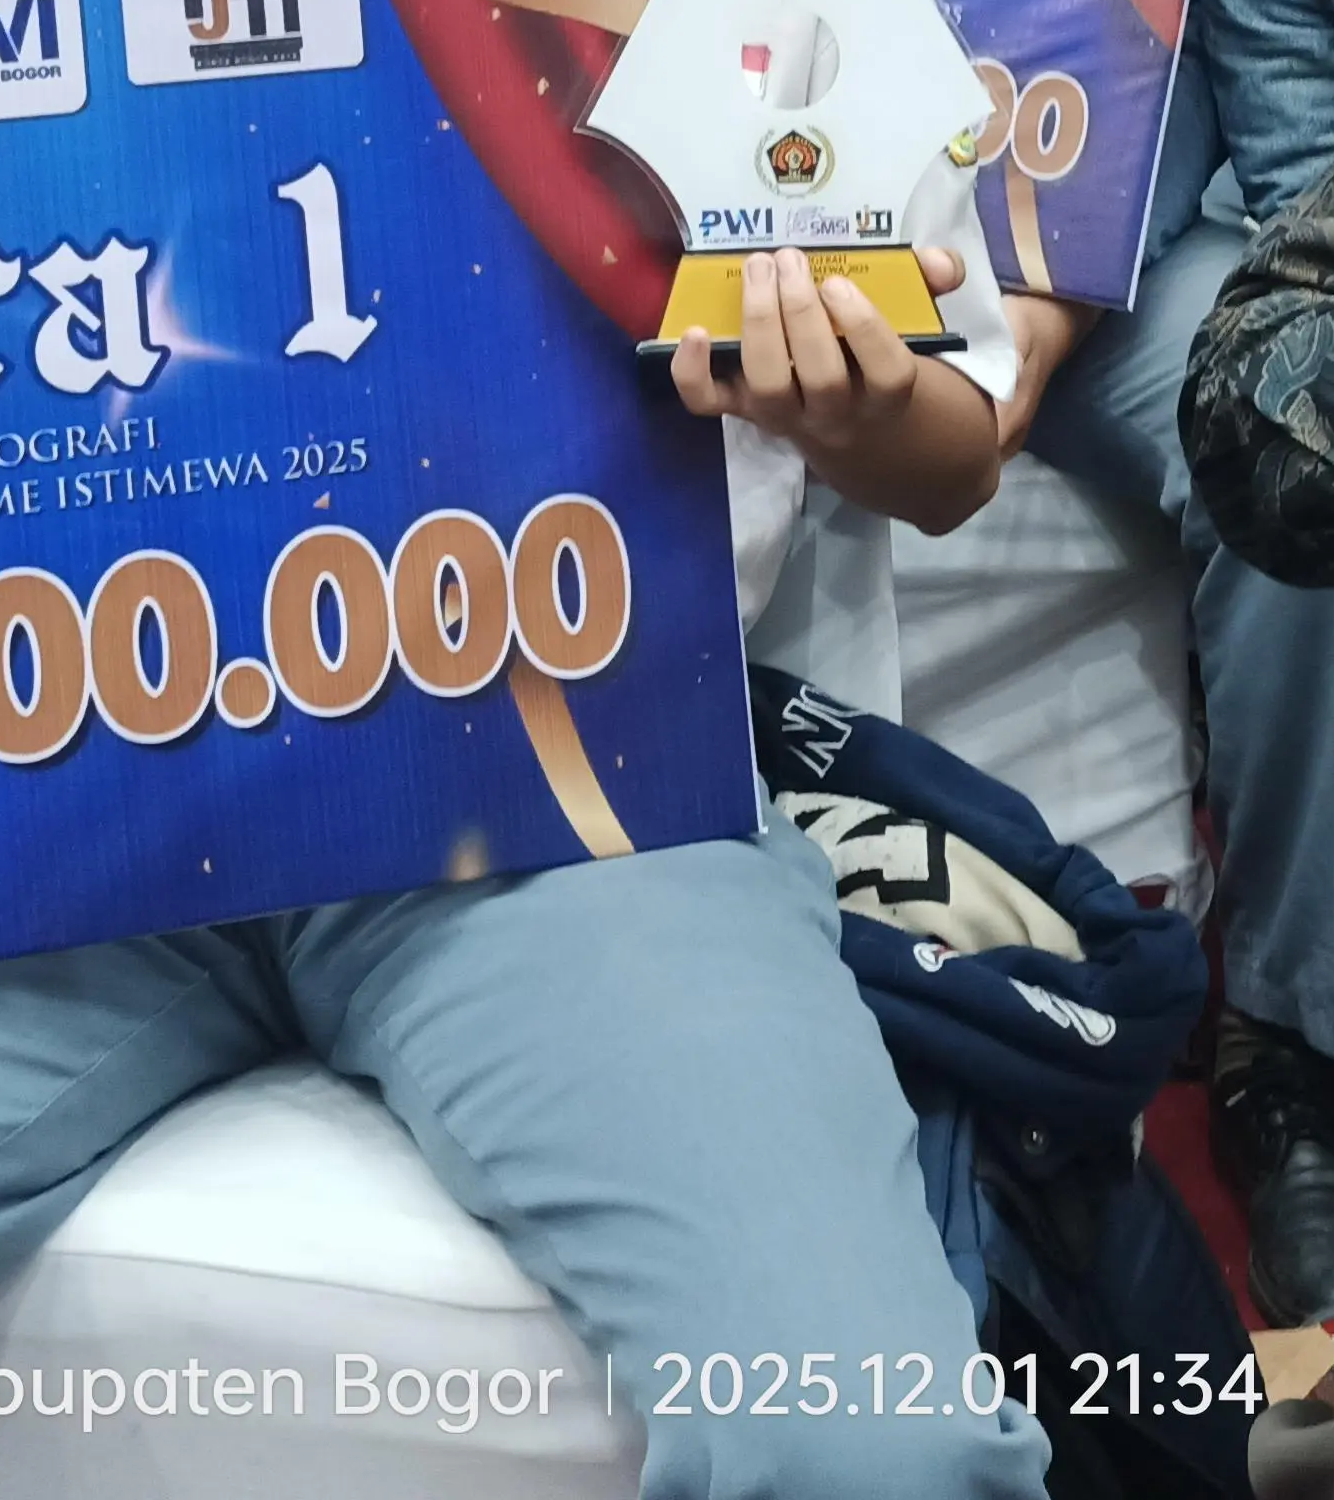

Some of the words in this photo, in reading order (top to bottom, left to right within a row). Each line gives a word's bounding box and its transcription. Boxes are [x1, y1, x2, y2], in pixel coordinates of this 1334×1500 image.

[0, 65, 63, 83] BOGOR
[699, 207, 774, 236] PWI
[57, 450, 269, 511] ISTIMEWA
[281, 436, 369, 482] 2025
